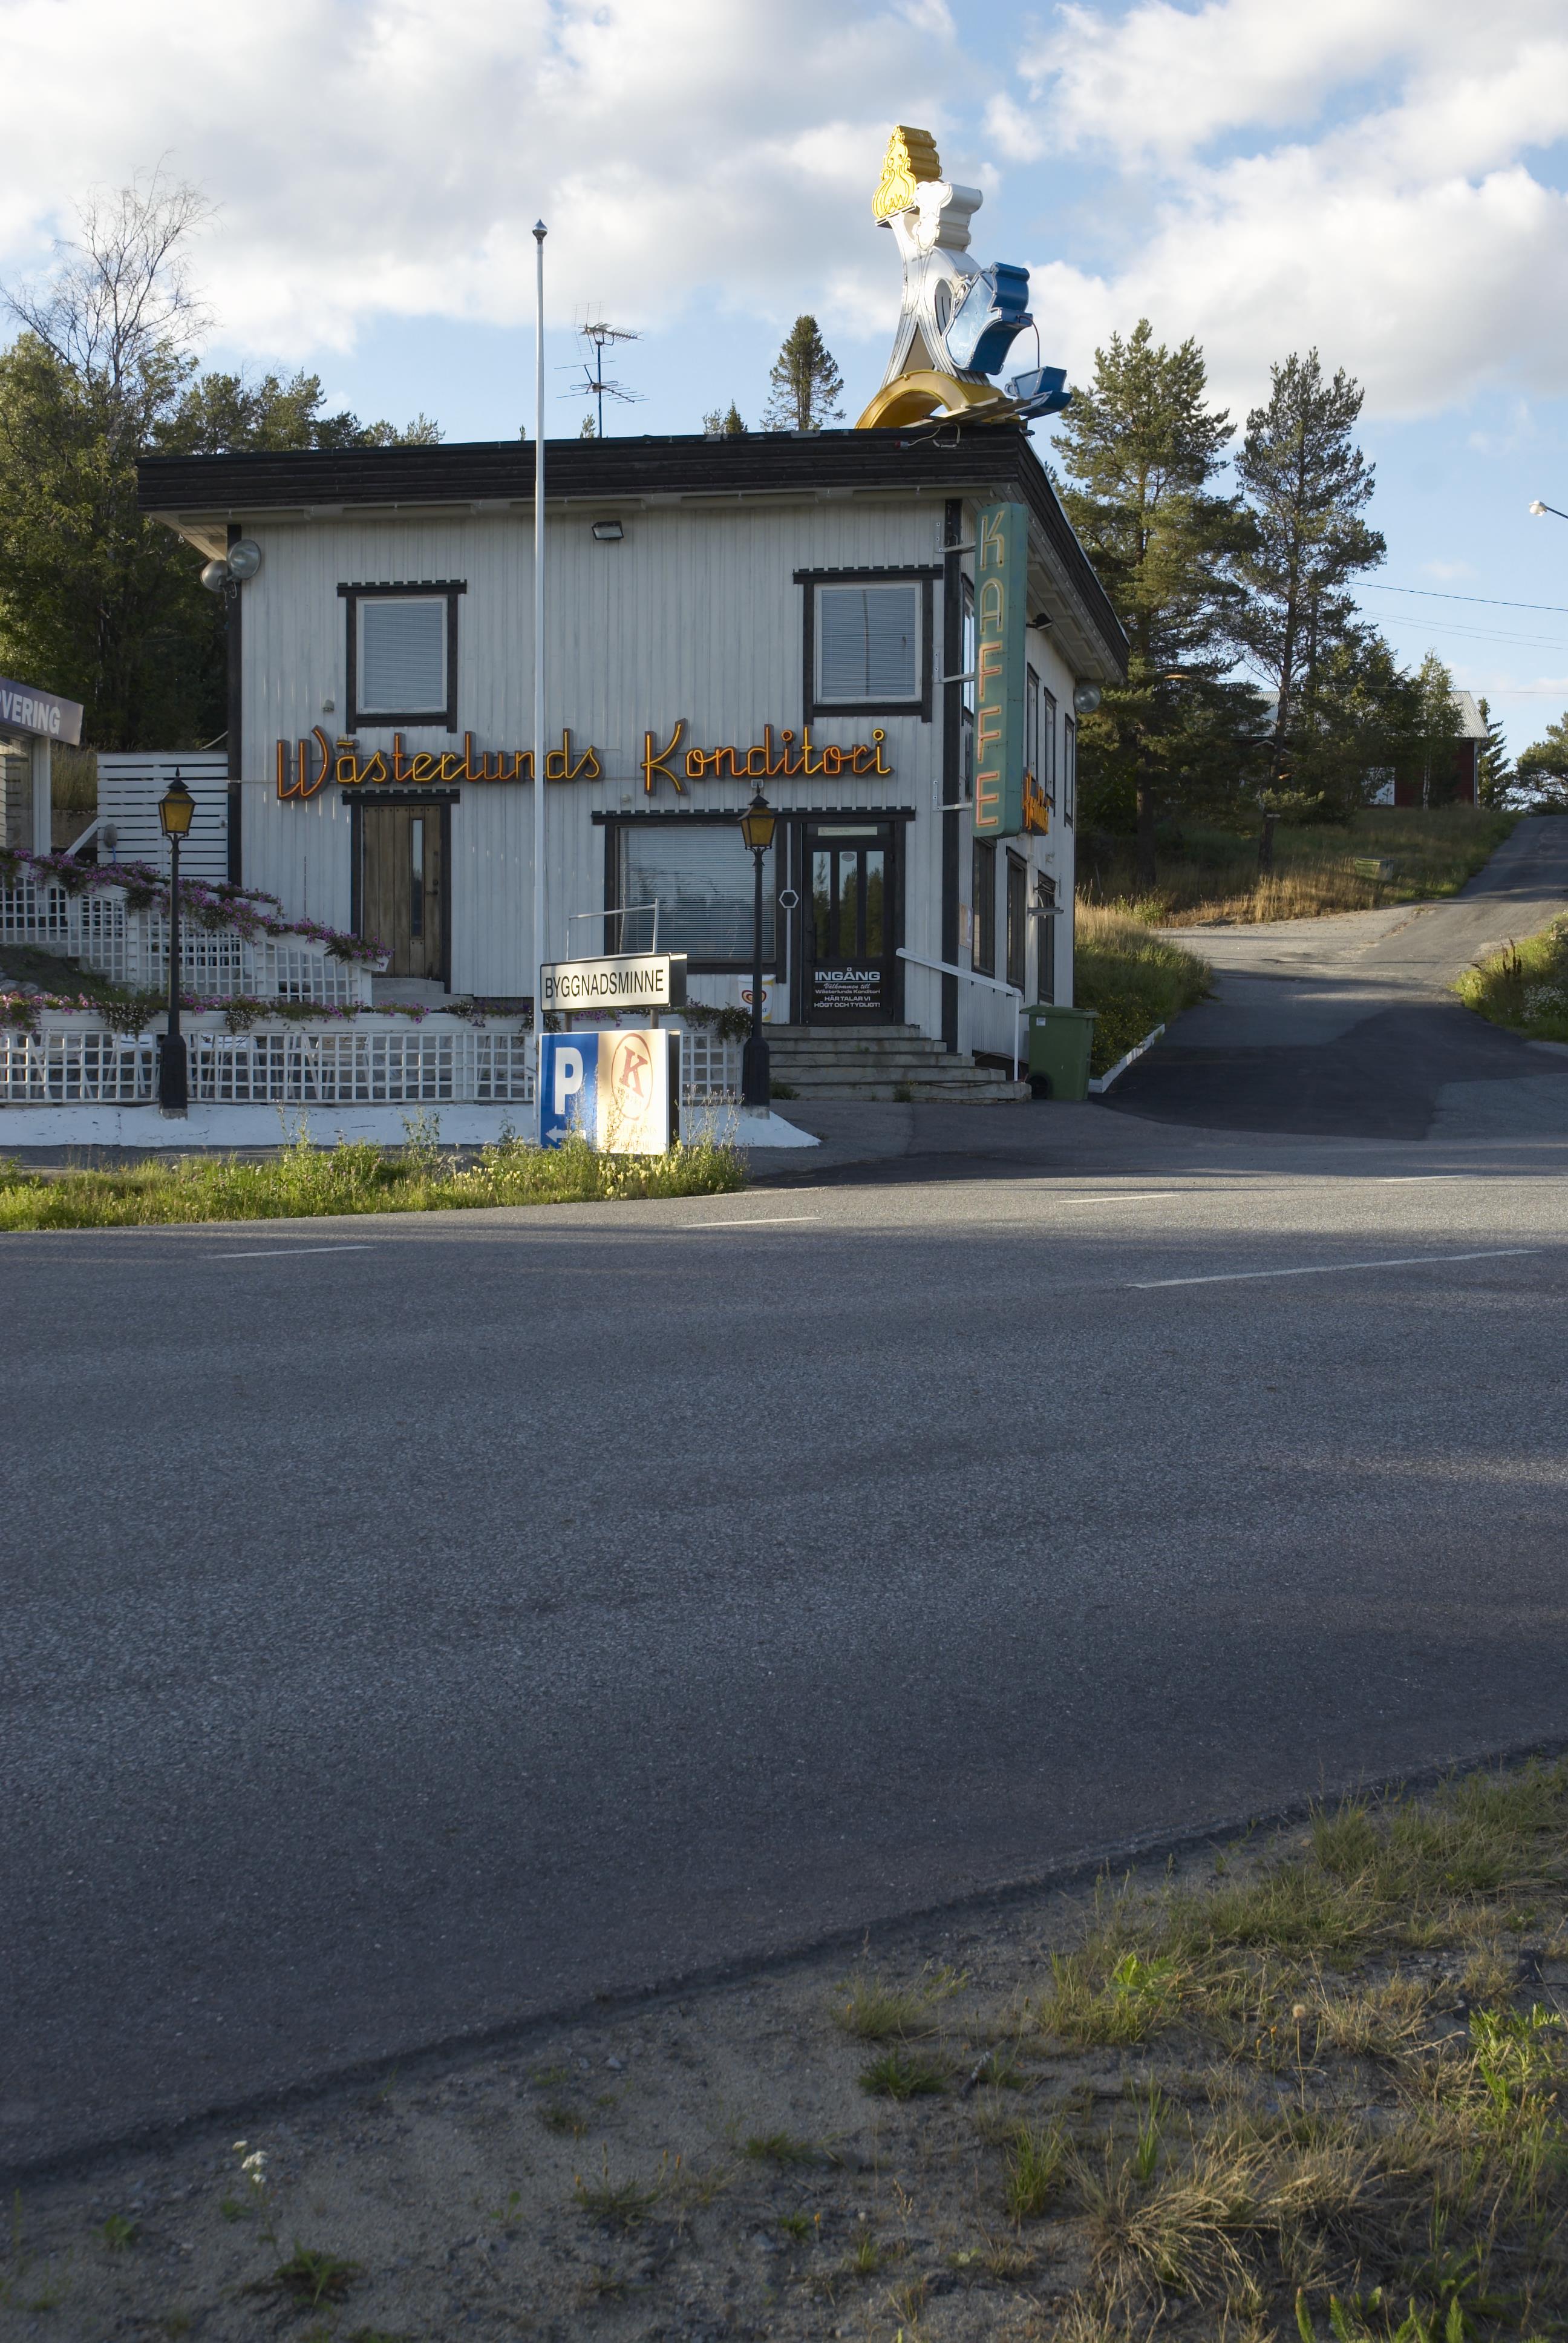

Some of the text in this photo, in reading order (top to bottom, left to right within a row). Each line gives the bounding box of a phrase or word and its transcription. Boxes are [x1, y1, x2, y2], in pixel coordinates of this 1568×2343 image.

[975, 510, 1005, 827] KAFFE
[0, 689, 60, 735] VERING
[277, 718, 895, 800] Wästerlunds Konditori
[545, 969, 664, 998] BYGGNADSMINNE
[815, 967, 880, 981] INGÅNG
[554, 1047, 584, 1115] P
[621, 1045, 648, 1098] K
